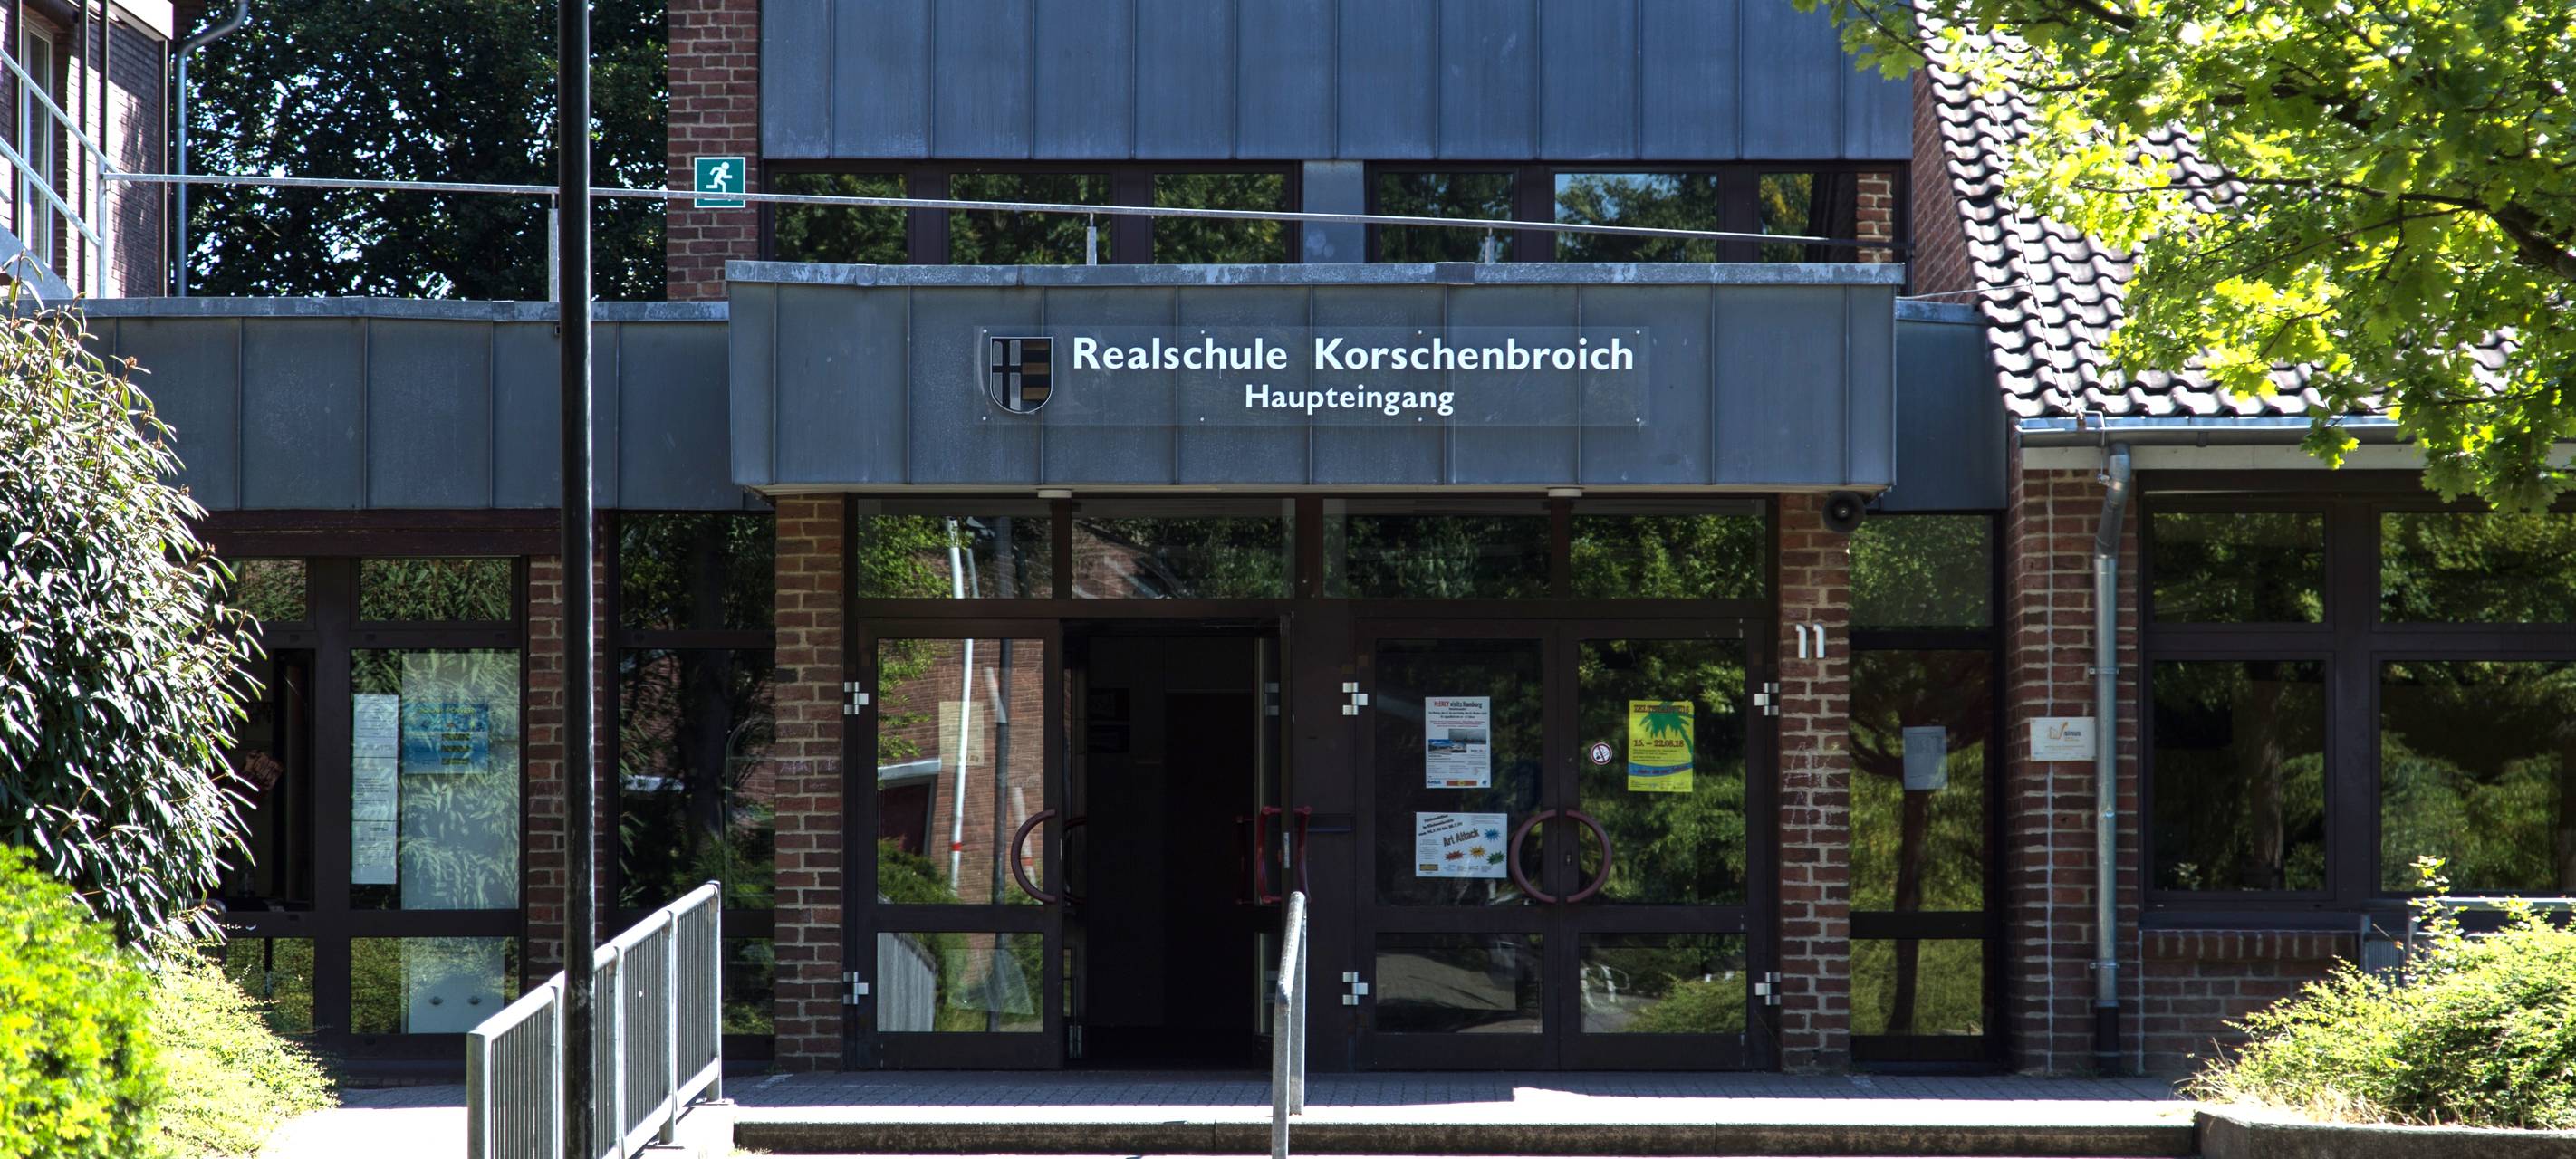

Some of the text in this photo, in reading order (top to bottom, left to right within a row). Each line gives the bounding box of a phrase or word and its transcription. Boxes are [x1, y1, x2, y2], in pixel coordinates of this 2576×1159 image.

[1074, 338, 1632, 369] Realschule Korschenbroich
[1246, 385, 1454, 416] Haupteingang
[1796, 624, 1824, 658] 11
[1443, 834, 1456, 848] Art
[1456, 827, 1480, 843] Attack
